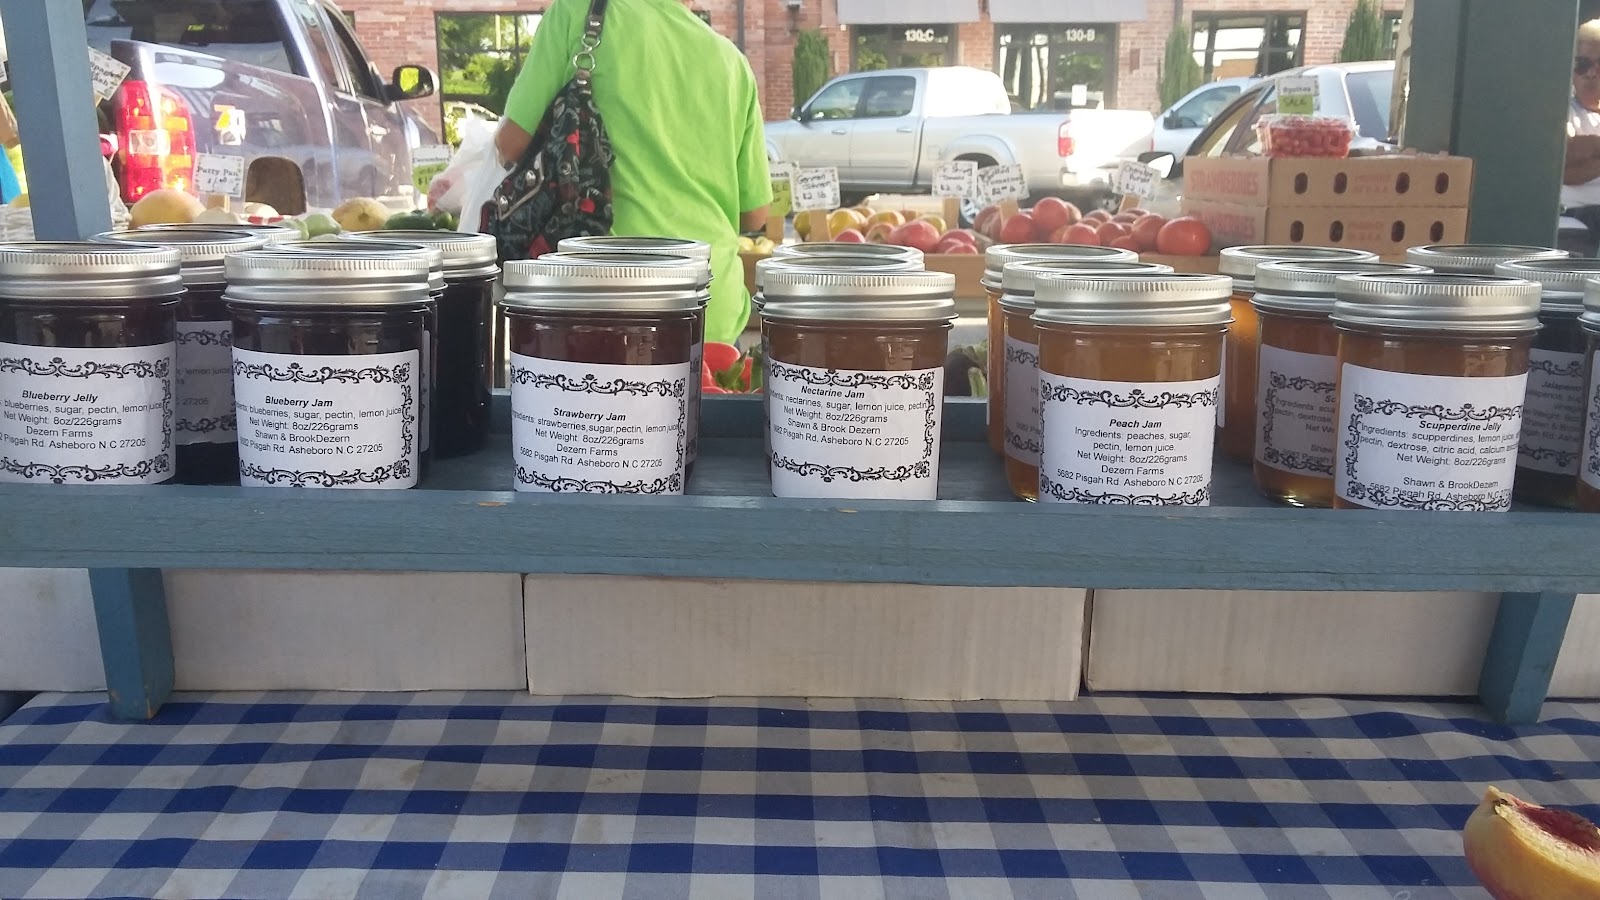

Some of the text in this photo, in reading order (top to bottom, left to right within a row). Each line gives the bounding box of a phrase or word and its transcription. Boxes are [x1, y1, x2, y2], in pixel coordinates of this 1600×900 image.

[904, 28, 935, 43] 130-C
[1064, 28, 1096, 42] 130-B
[1190, 169, 1259, 197] STRAWBERRIES
[22, 390, 98, 403] Blueberry Jelly
[801, 385, 865, 398] Nectarine Jam
[4, 401, 51, 414] blueberries,
[55, 405, 83, 416] sugar,
[88, 405, 119, 415] pectin,
[122, 404, 148, 413] lemon
[265, 396, 333, 408] Blueberry Jam
[785, 395, 822, 408] nectarines,
[826, 402, 851, 411] sugar,
[855, 402, 883, 411] lemon
[4, 411, 16, 421] Net
[53, 417, 122, 427] 8oz/226grams
[250, 406, 291, 419] blueberries,
[294, 411, 320, 421] sugar,
[325, 410, 355, 420] pectin,
[359, 408, 385, 418] lemon
[553, 407, 626, 422] Strawberry Jam
[783, 406, 794, 415] Net
[825, 412, 888, 424] 8oz/226grams
[250, 417, 260, 427] Net
[292, 422, 358, 432] 8oz/226grams
[787, 418, 810, 430] Shawn
[813, 422, 819, 431] &
[820, 424, 846, 434] Brook
[1109, 418, 1162, 429] Peach Jam
[1419, 420, 1502, 432] Scupperdine Jelly
[62, 429, 93, 438] Farms
[255, 430, 278, 441] Shawn
[281, 433, 287, 441] &
[535, 428, 548, 438] Net
[582, 435, 644, 446] 8oz/226grams
[783, 428, 803, 441] Pisgah
[820, 435, 862, 446] Asheboro
[884, 437, 909, 445] 27205
[1127, 431, 1166, 441] peaches,
[1477, 433, 1500, 443] lemon
[4, 434, 29, 447] Pisgah
[49, 440, 96, 450] Asheboro
[120, 438, 146, 448] 27205
[250, 439, 271, 452] Pisgah
[289, 445, 333, 455] Asheboro
[356, 444, 383, 454] 27205
[1093, 441, 1121, 452] pectin,
[1125, 443, 1152, 452] lemon
[1359, 435, 1384, 448] pectin,
[1387, 440, 1429, 453] dextrose,
[1433, 445, 1454, 454] citric
[1457, 445, 1477, 455] acid,
[520, 446, 533, 458] 5682
[534, 450, 559, 464] Pisgah
[577, 458, 620, 468] Asheboro
[641, 459, 662, 468] 27205
[590, 447, 618, 456] Farms
[1077, 450, 1091, 461] Net
[1129, 455, 1188, 466] 8oz/226grams
[1396, 452, 1413, 463] Net
[1454, 457, 1506, 467] 8oz/226grams
[1057, 468, 1073, 480] 5682
[1075, 473, 1104, 485] Pisgah
[1124, 477, 1166, 487] Asheboro
[1184, 474, 1203, 484] 27205
[1137, 466, 1164, 475] Farms
[1403, 477, 1435, 489] Shawn
[1439, 481, 1444, 489] &
[1369, 482, 1390, 494] 5682
[1392, 488, 1425, 500] Pisgah
[1446, 492, 1485, 500] Asheboro
